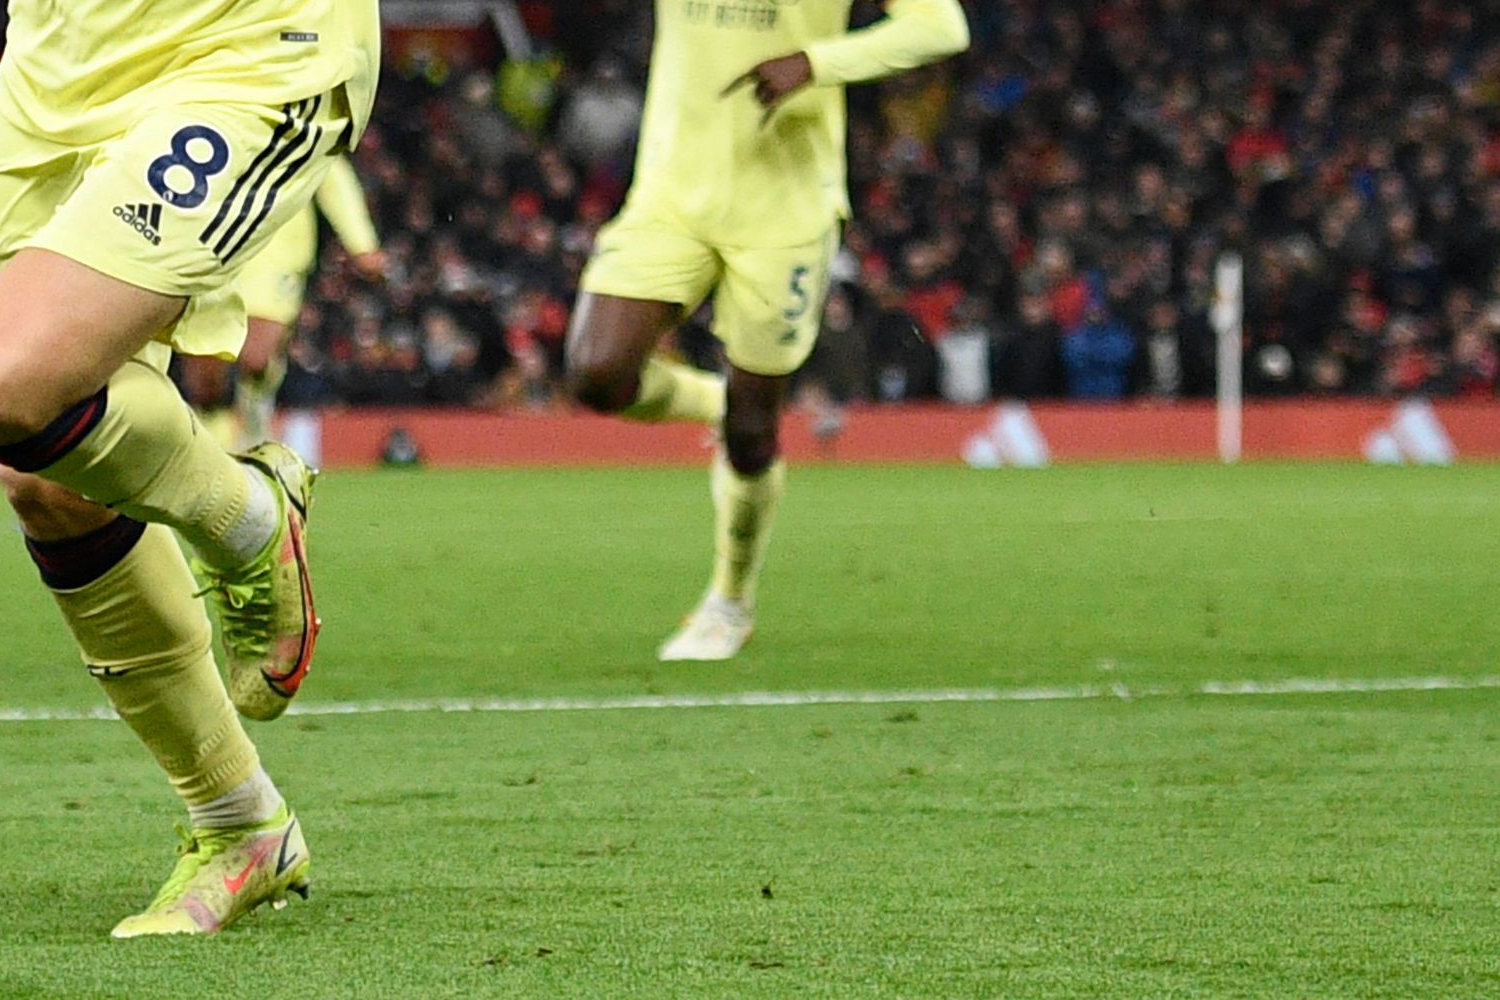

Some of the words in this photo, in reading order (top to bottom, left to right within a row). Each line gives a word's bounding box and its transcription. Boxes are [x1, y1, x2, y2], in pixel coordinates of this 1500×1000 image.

[147, 125, 229, 209] 8
[112, 206, 162, 246] adidas
[783, 264, 810, 320] 5
